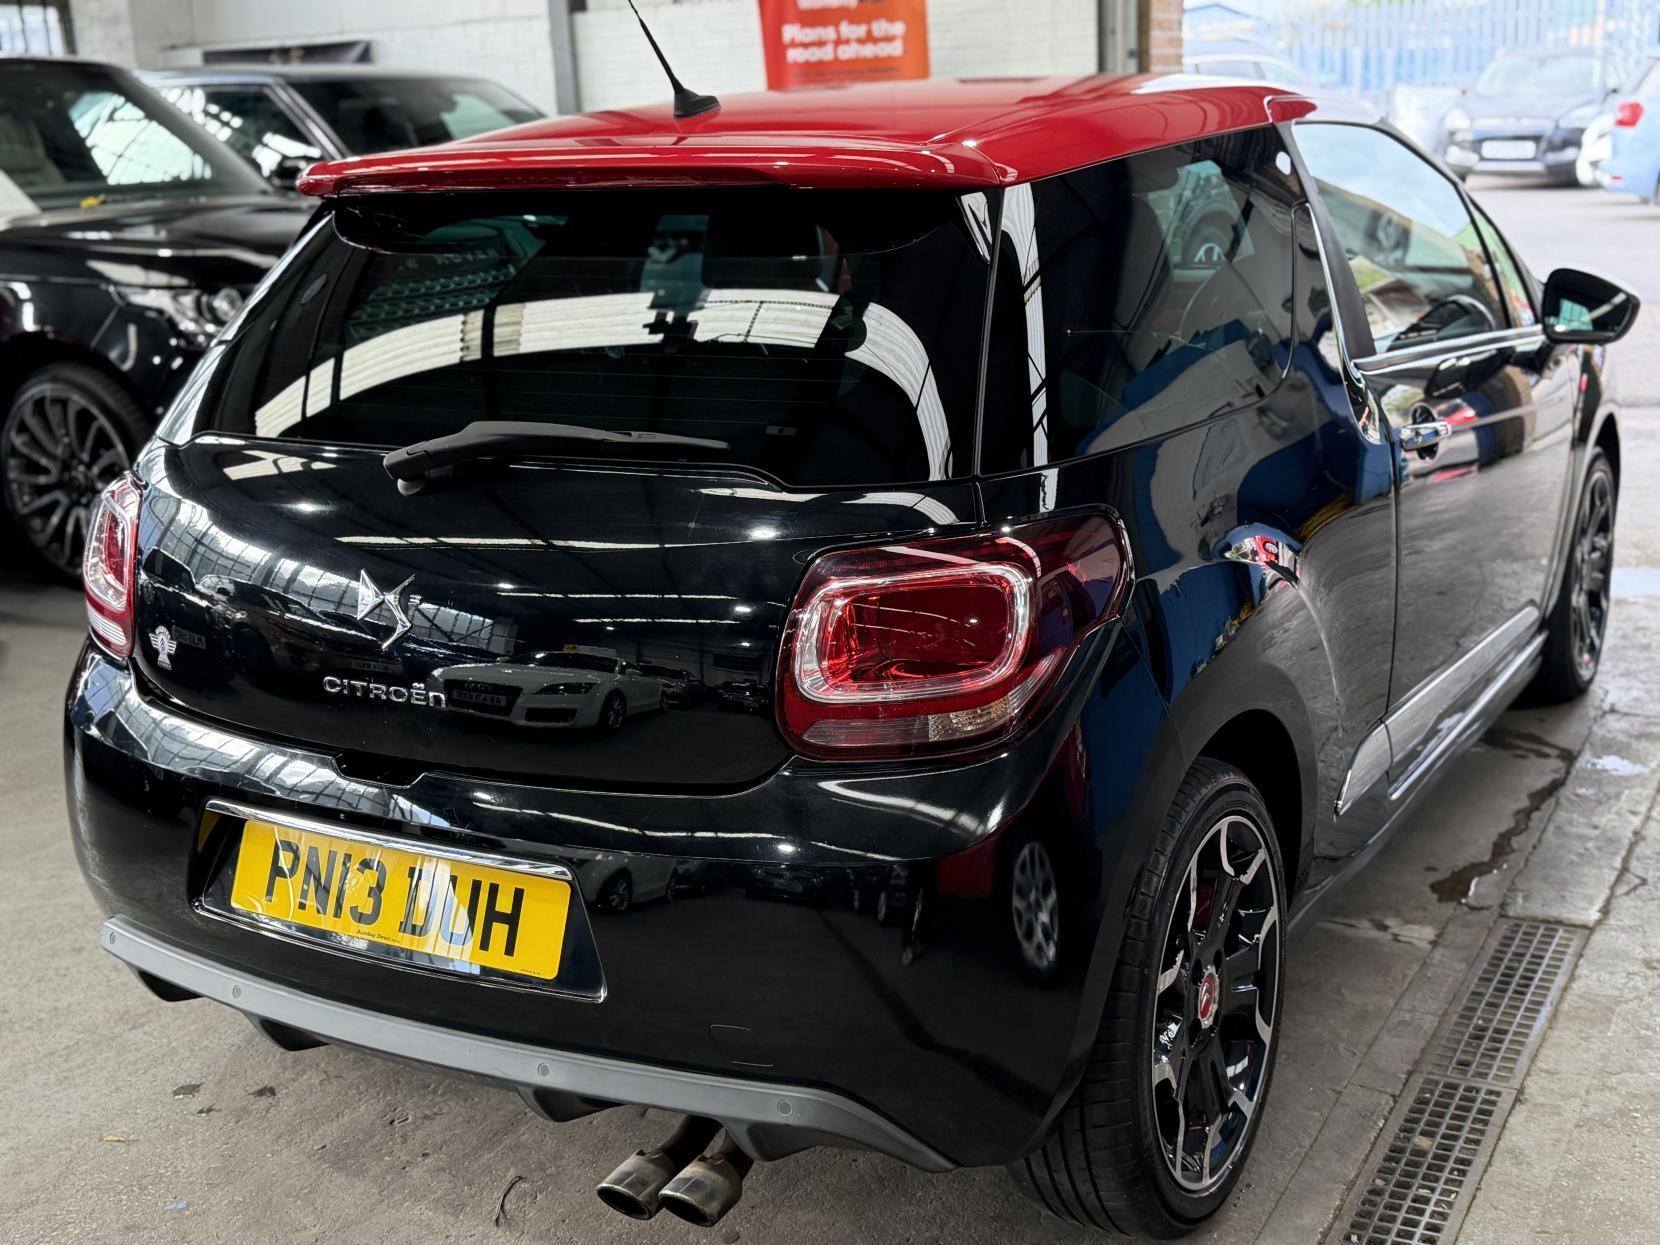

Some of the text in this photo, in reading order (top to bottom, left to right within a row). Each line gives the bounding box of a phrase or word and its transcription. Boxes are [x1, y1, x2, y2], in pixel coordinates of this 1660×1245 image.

[782, 18, 906, 45] Plans for the
[786, 39, 903, 63] road ahead
[263, 840, 526, 957] PN13 DUH
